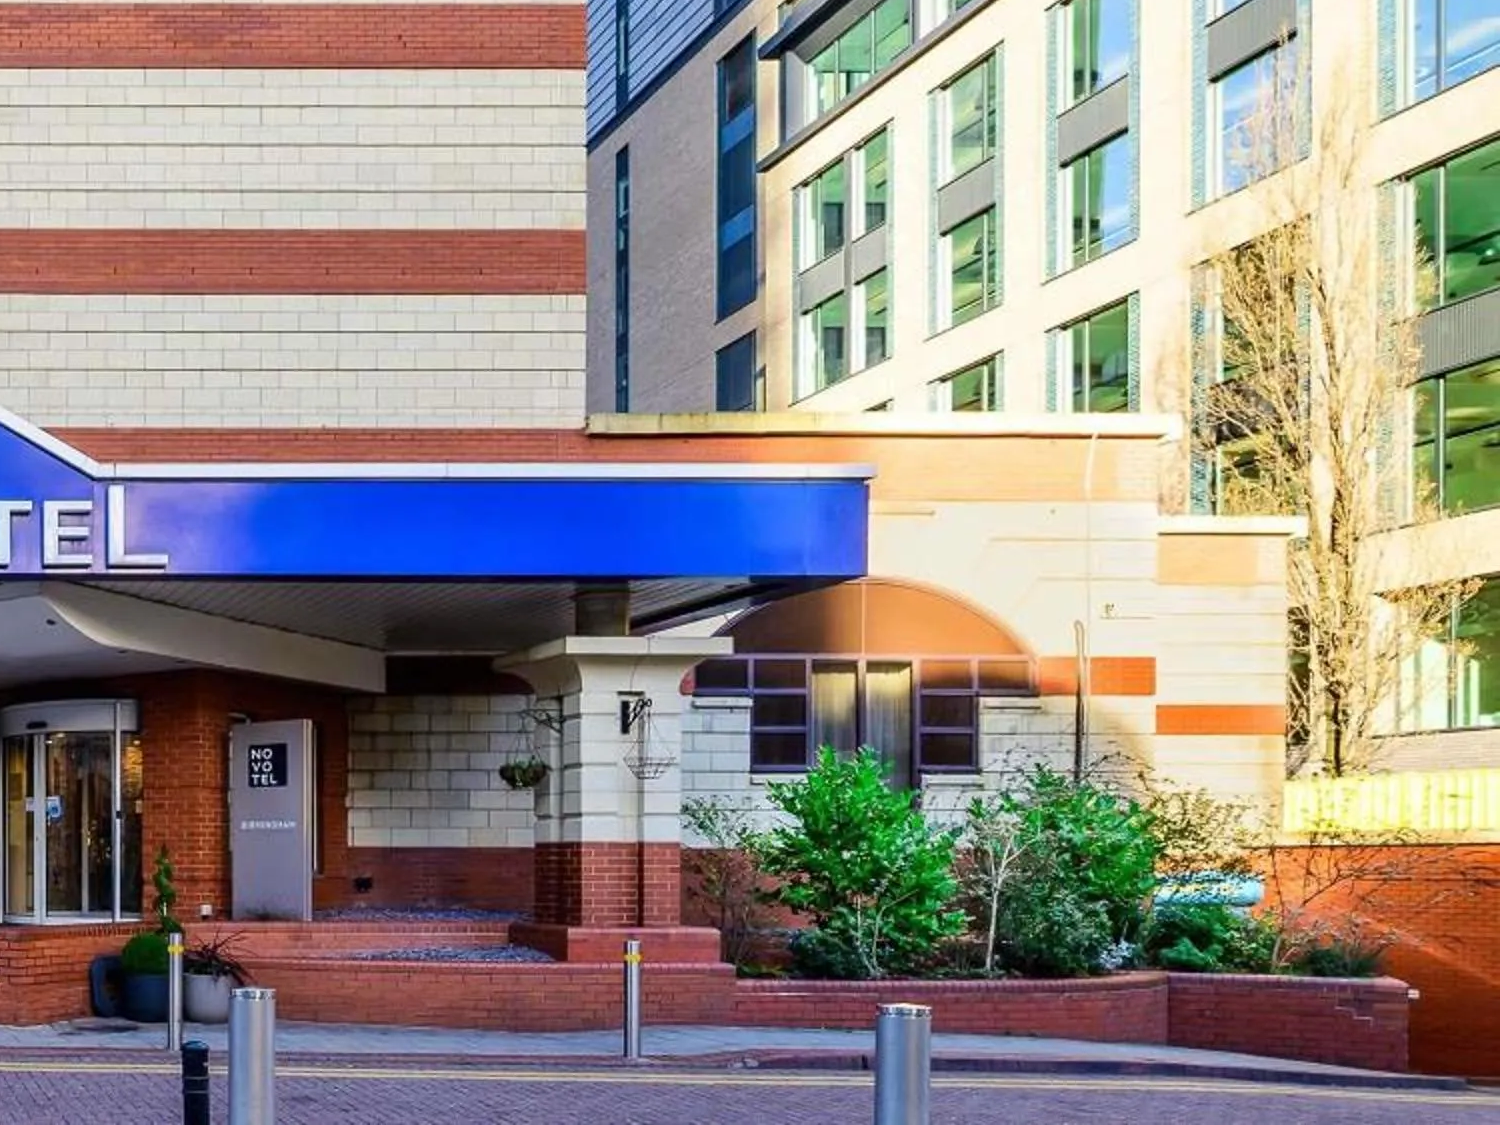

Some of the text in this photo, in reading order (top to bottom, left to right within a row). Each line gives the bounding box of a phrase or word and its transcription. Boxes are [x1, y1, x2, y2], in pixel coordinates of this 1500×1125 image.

[251, 748, 273, 759] NO
[251, 761, 273, 772] VO
[251, 774, 277, 785] TEL
